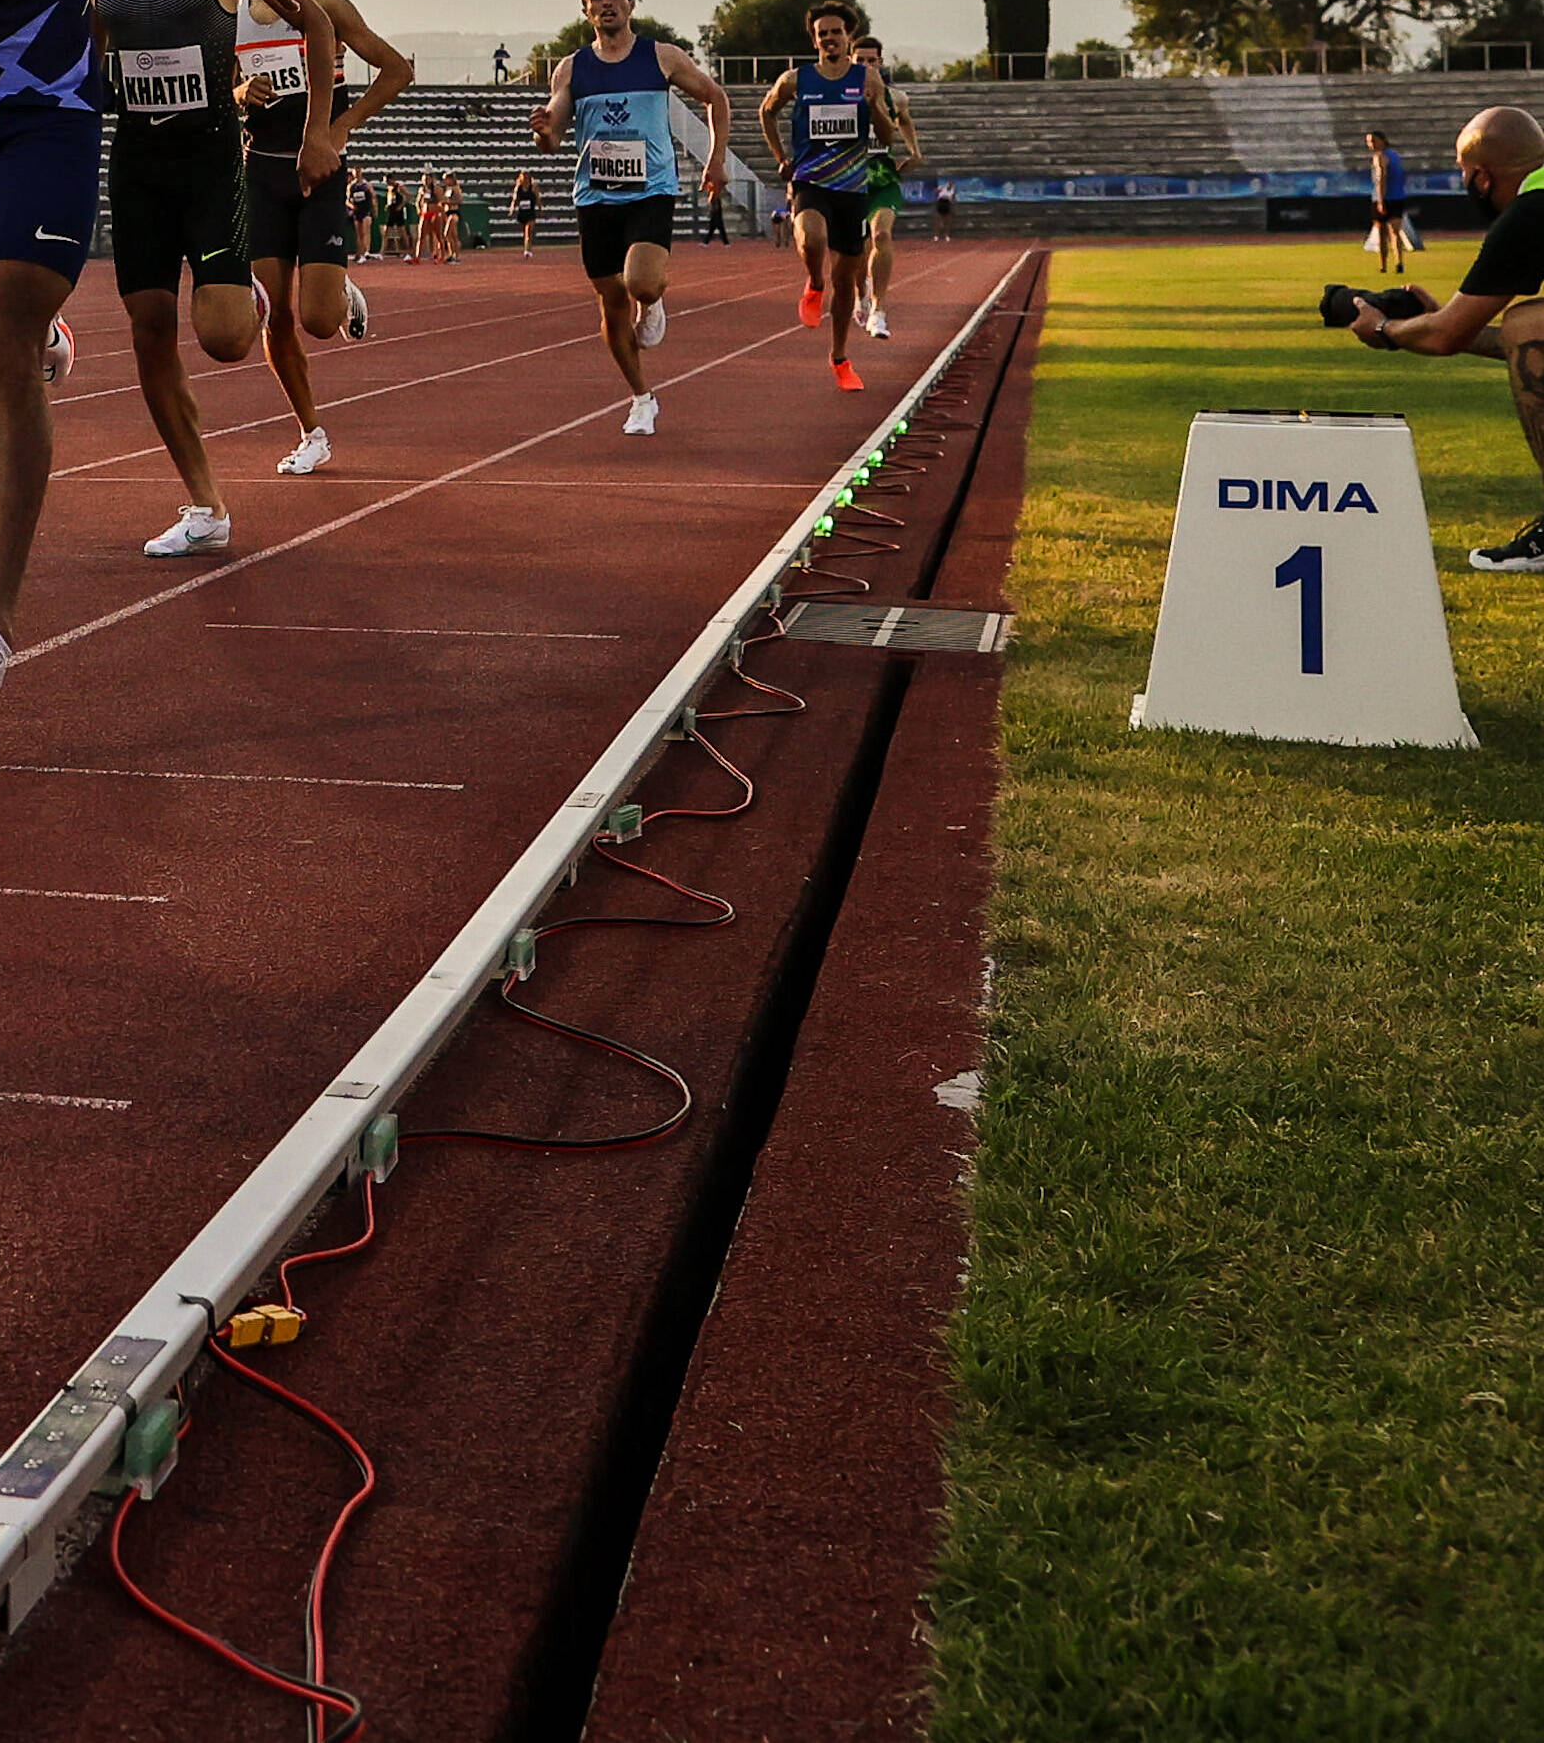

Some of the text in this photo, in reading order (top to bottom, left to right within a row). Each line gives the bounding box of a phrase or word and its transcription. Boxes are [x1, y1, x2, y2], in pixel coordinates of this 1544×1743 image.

[124, 73, 204, 106] KHATIR
[591, 157, 644, 178] PURCELL
[1217, 478, 1379, 514] DIMA
[1274, 545, 1324, 675] 1
